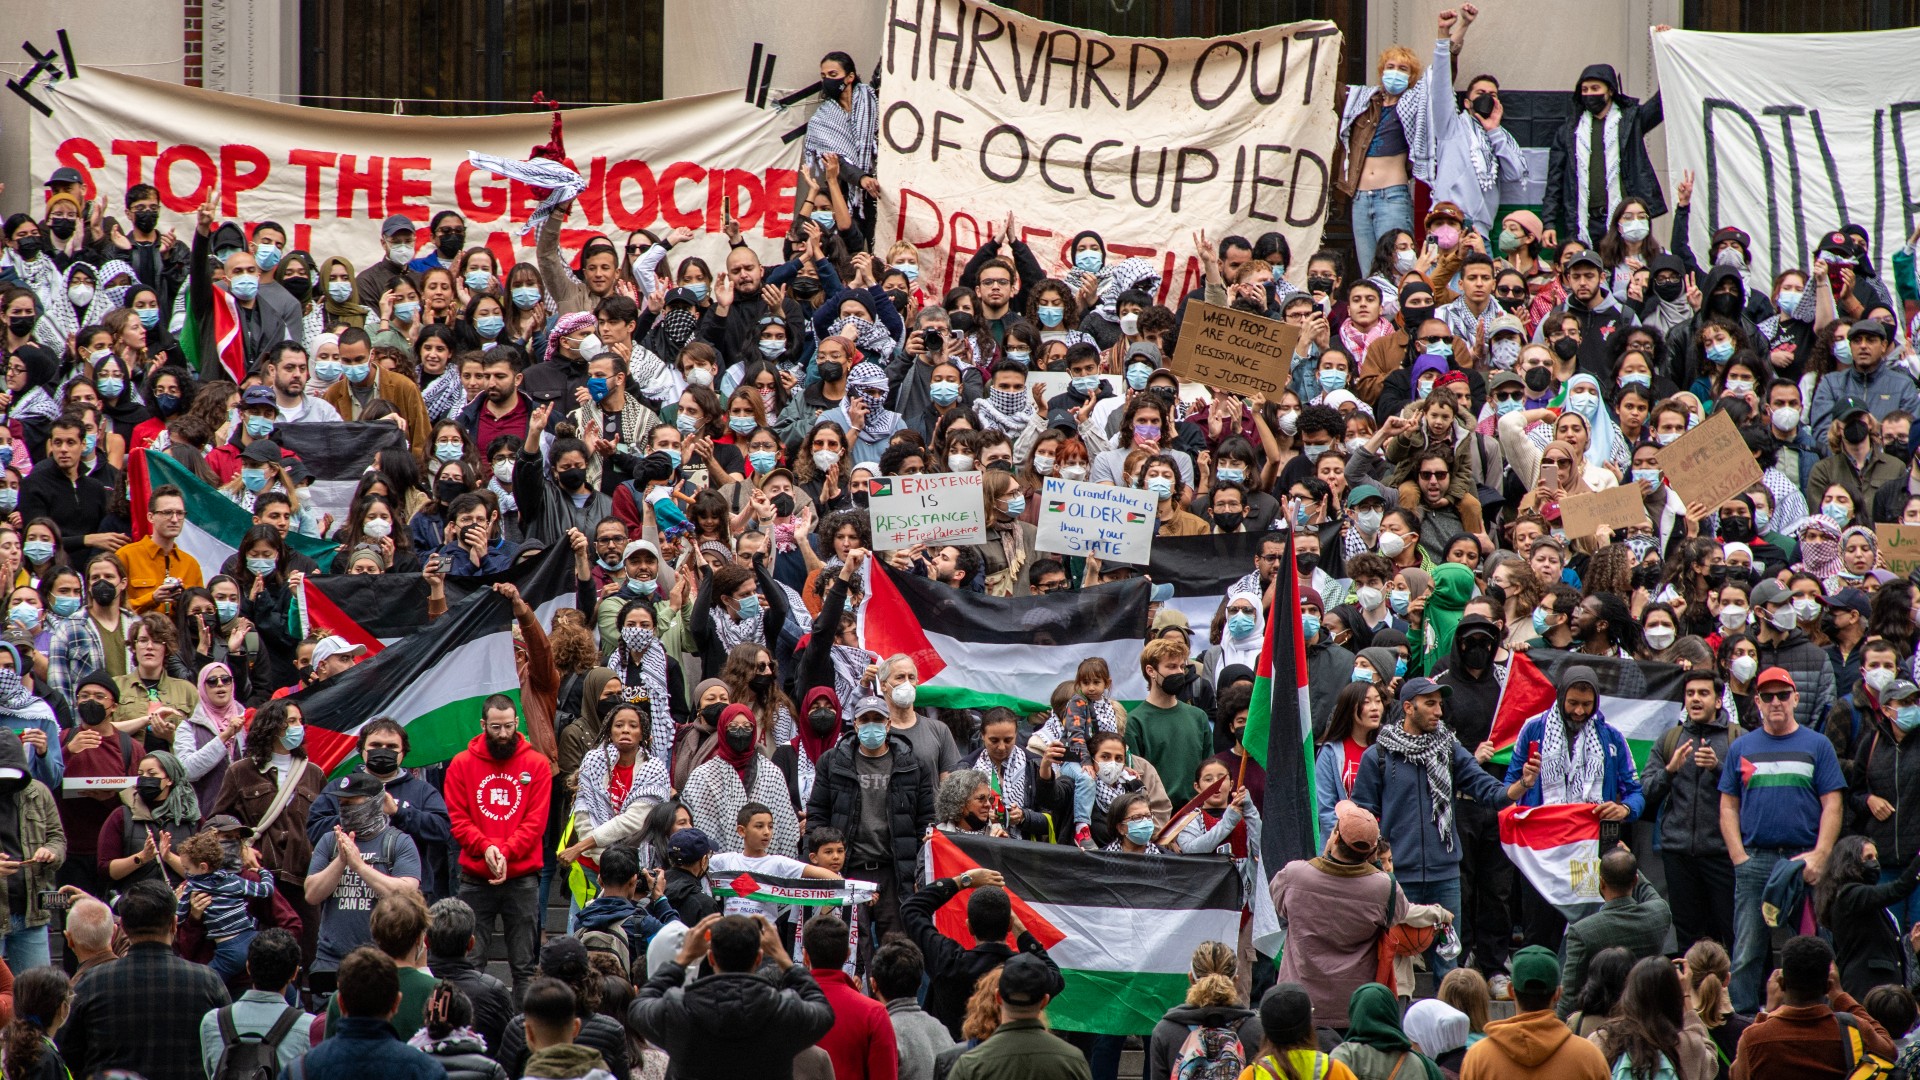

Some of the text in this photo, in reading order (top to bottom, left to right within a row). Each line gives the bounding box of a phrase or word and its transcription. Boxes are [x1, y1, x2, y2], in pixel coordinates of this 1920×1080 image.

[887, 0, 1338, 110] HARVARD OUT
[883, 100, 1328, 228] OF OCCUPIED
[45, 137, 270, 218] STOP
[289, 149, 432, 222] THE
[1203, 310, 1280, 343] WHEN PEOPLE
[1200, 327, 1282, 358] ARE OCCUPIED
[1194, 344, 1260, 371] RESISTANCE
[1195, 363, 1278, 393] IS JUSTIFIED
[901, 475, 982, 494] EXISTENCE
[1046, 480, 1065, 494] MY
[1073, 484, 1139, 507] Grandfather
[921, 494, 939, 508] IS
[1068, 503, 1123, 525] OLDER
[891, 526, 979, 543] #FreePalestine
[1058, 521, 1127, 540] than your
[332, 886, 362, 898] KNOWS
[338, 898, 371, 910] CAN BE
[771, 886, 835, 899] PALESTINE
